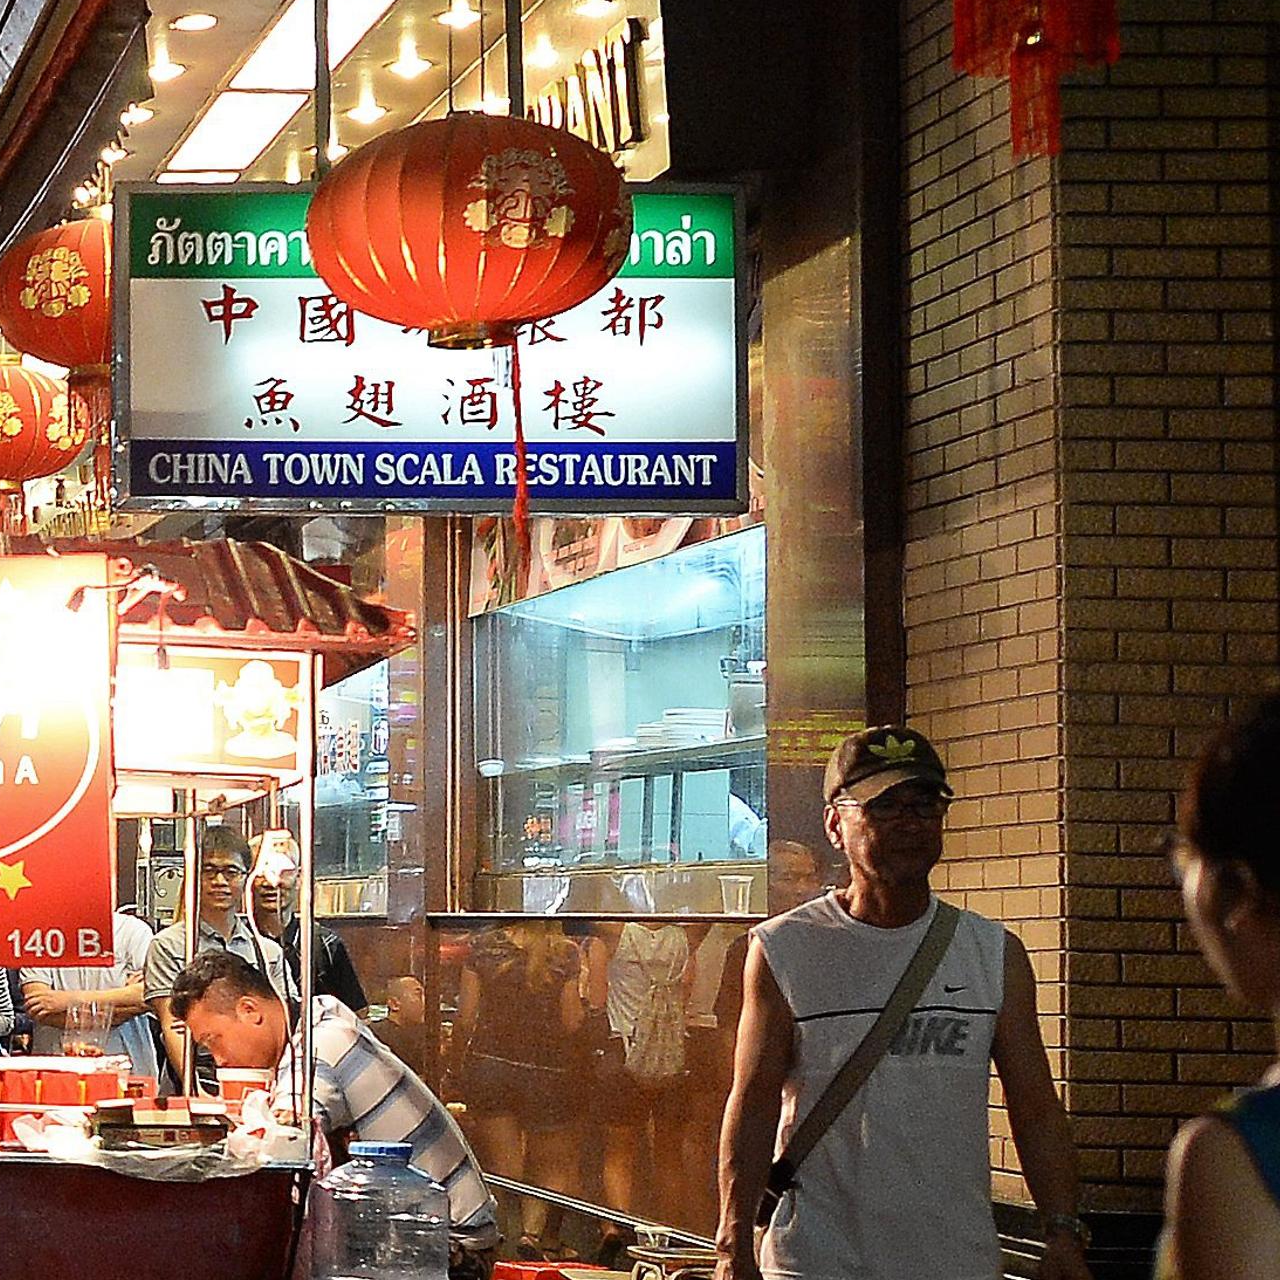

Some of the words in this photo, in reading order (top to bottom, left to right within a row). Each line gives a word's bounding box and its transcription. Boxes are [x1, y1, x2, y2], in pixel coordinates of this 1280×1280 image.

[243, 374, 616, 438] 魚翅酒樓
[147, 451, 254, 487] CHINA
[262, 451, 365, 486] TOWN
[374, 451, 485, 486] SCALA
[492, 451, 718, 487] RESTAURANT
[14, 753, 40, 786] A
[7, 929, 65, 958] 140
